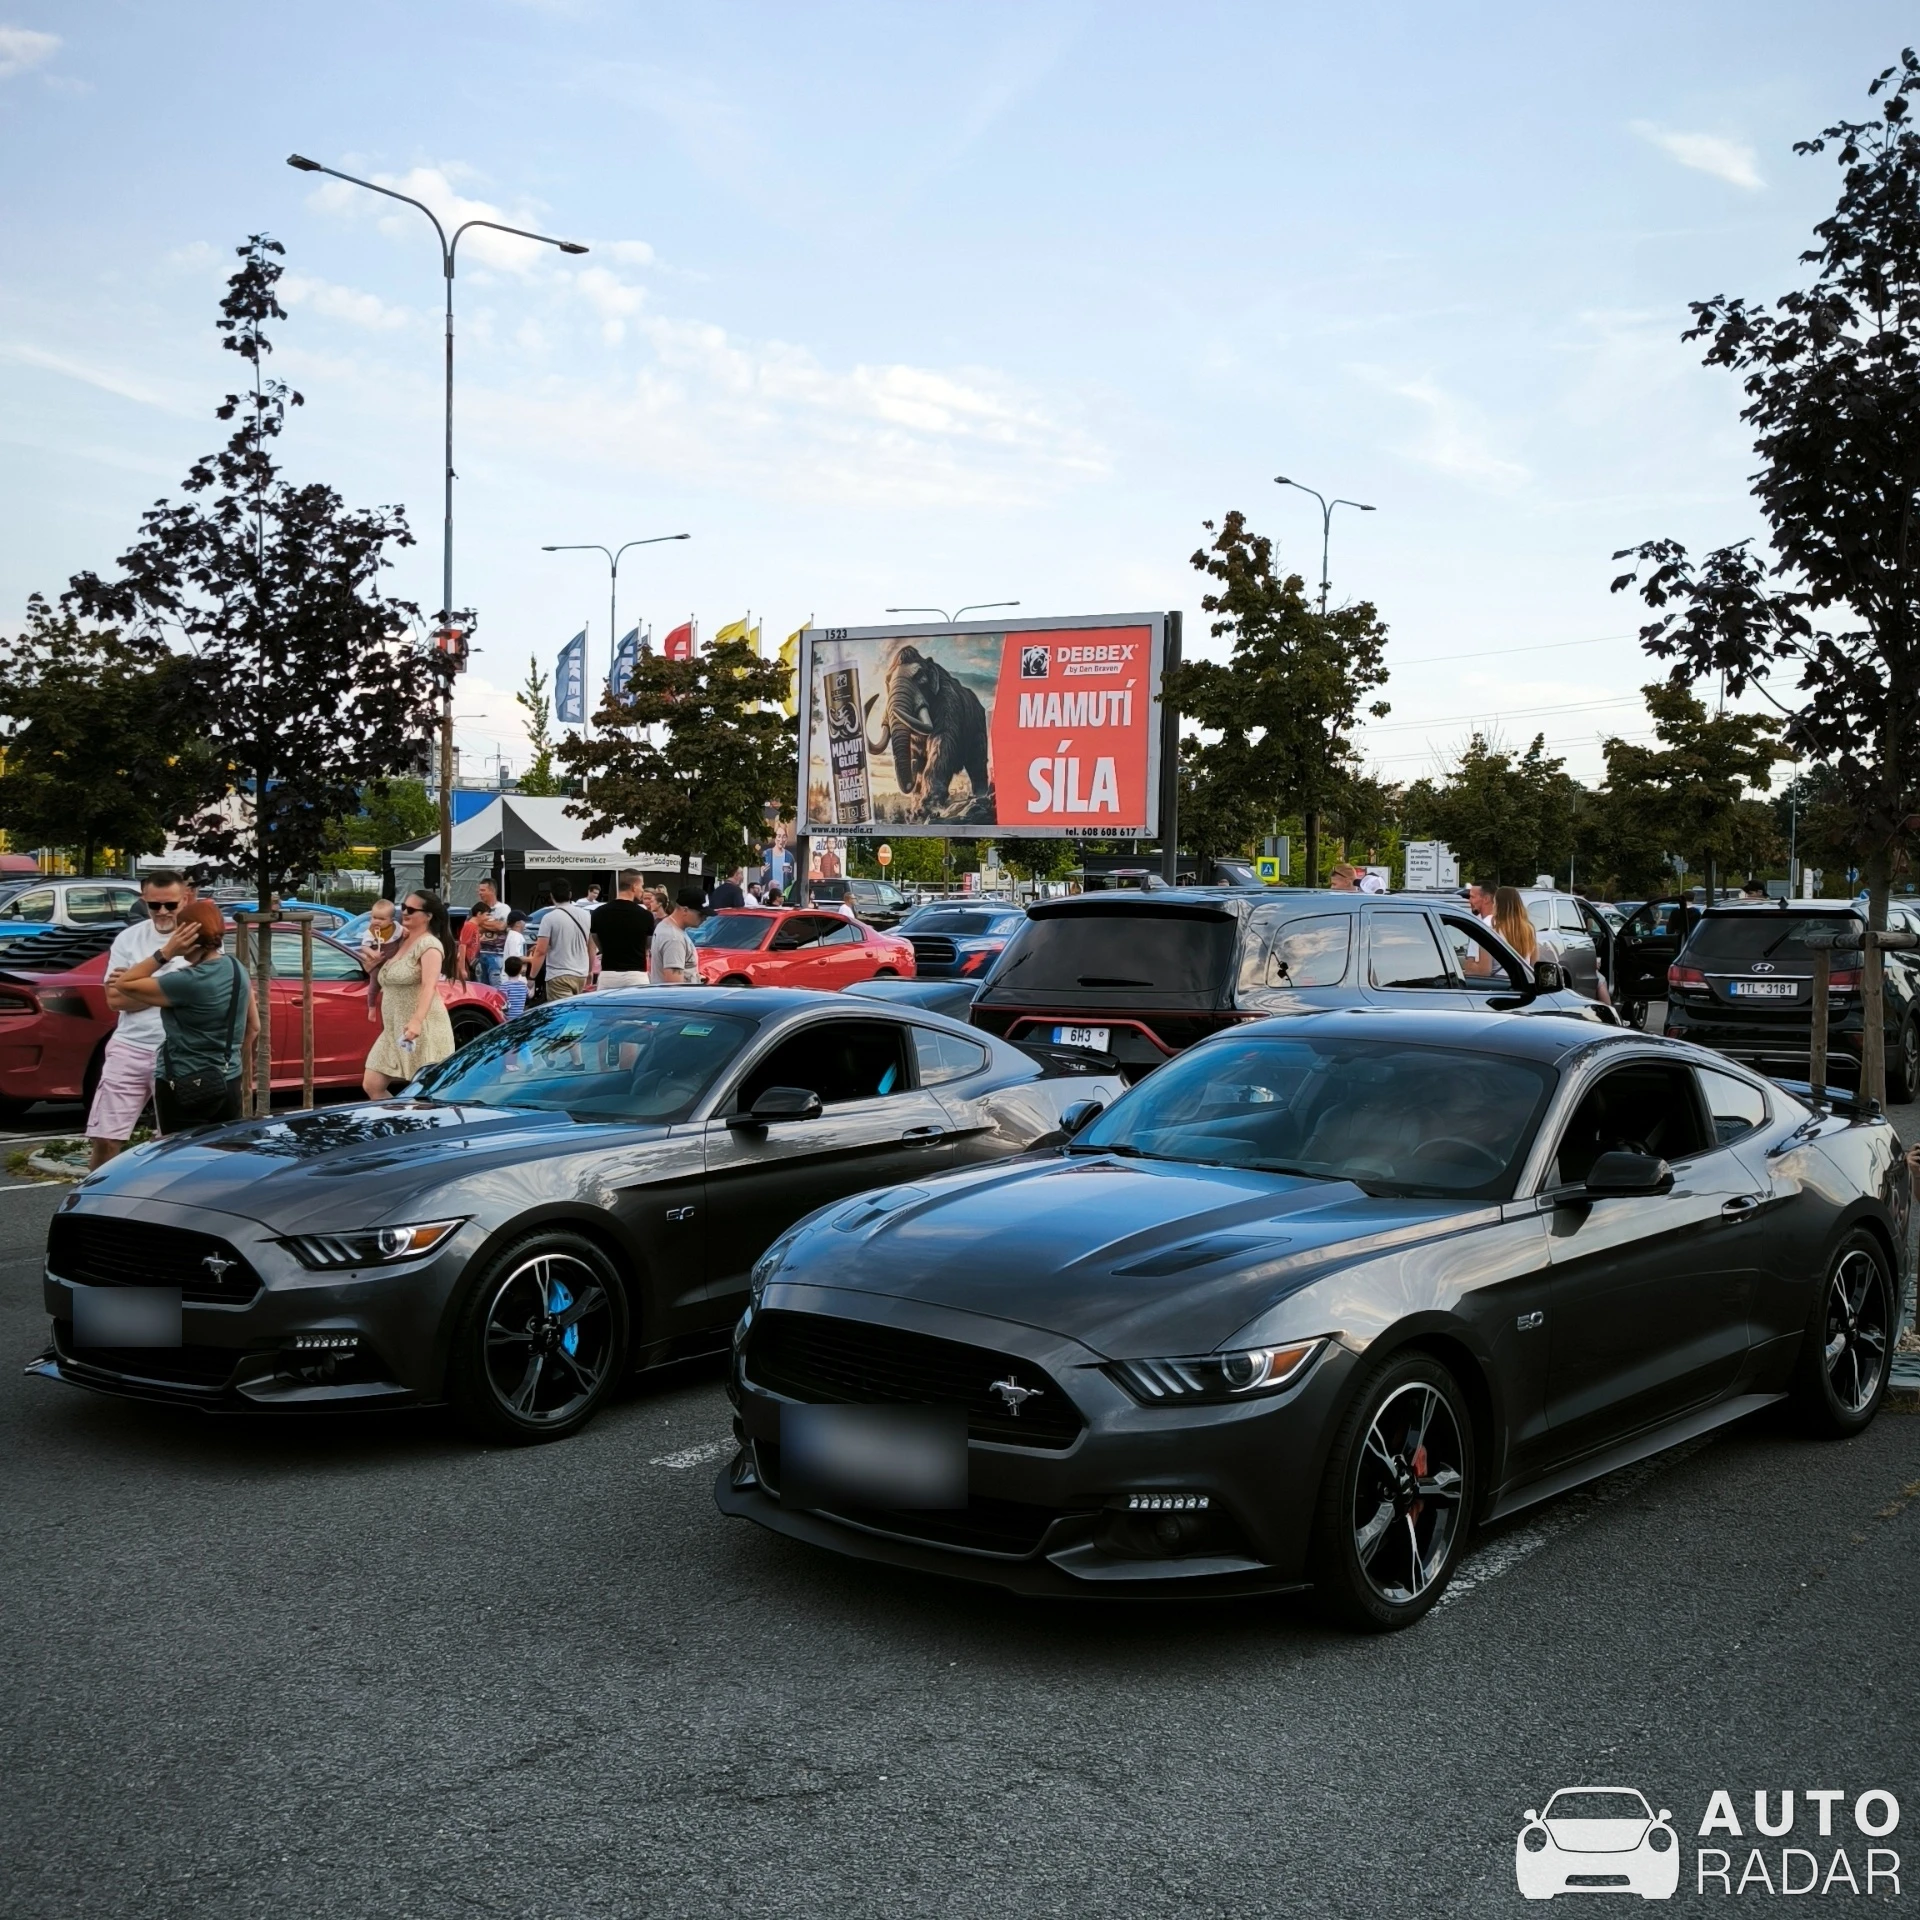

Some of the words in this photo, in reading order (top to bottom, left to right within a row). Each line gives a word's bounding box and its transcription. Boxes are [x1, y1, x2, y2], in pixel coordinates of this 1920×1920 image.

[825, 629, 847, 640] 1523
[1057, 644, 1134, 663] DEBBEX
[1069, 665, 1078, 673] by
[567, 647, 581, 718] IKEA
[1018, 678, 1137, 728] MAMUTÍ
[832, 738, 862, 758] MAMUT
[839, 754, 859, 768] GLUE
[838, 775, 863, 790] FIXACE
[1027, 739, 1120, 813] SÍLA
[811, 825, 873, 835] www.aspmedia.cz
[1065, 827, 1079, 836] tel.
[1081, 827, 1098, 837] 608
[1100, 827, 1117, 837] 608
[1119, 827, 1137, 837] 617
[1740, 983, 1758, 994] 1TL
[1766, 983, 1793, 994] 3181
[1070, 1029, 1092, 1042] 6H3
